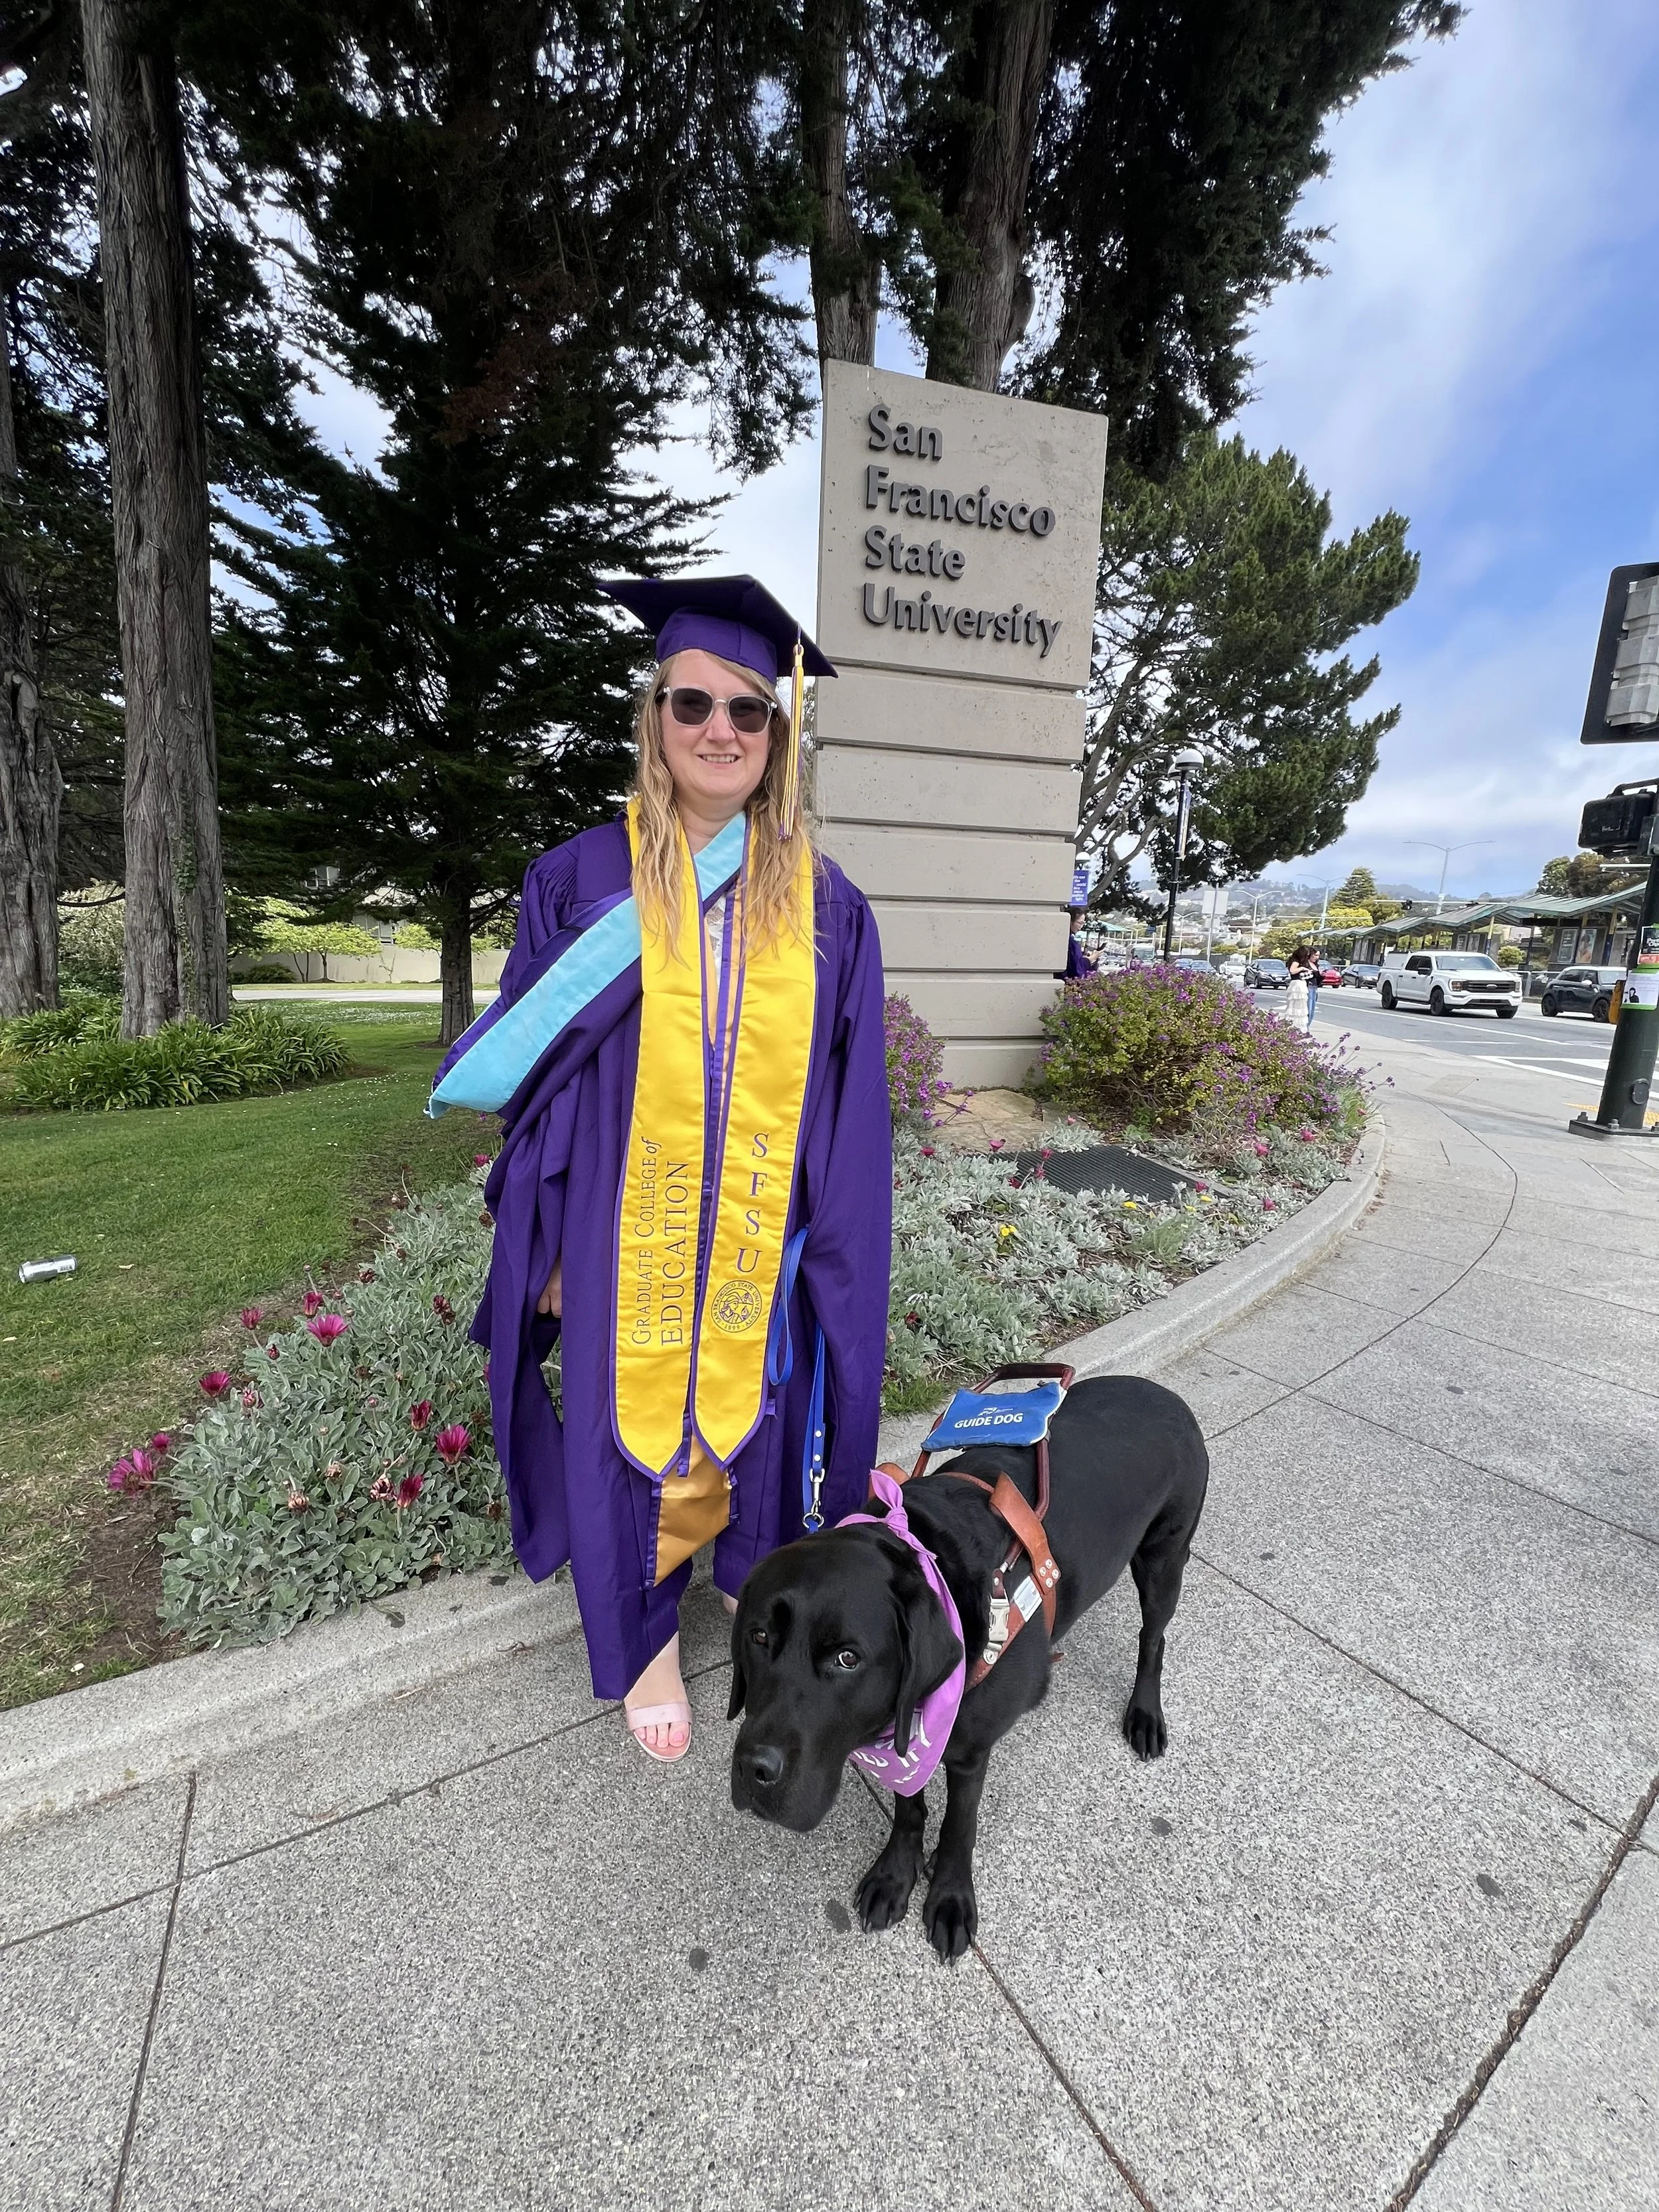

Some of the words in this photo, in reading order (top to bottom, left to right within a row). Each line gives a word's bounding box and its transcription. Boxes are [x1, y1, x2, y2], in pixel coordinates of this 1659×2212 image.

[868, 404, 943, 461] San
[866, 465, 1056, 536] Francisco
[865, 525, 966, 579] State
[863, 582, 1062, 658] University
[641, 1136, 662, 1153] of
[634, 1157, 656, 1237] COLLEGE
[737, 1132, 769, 1273] SFSU
[660, 1161, 689, 1346] EDUCATION
[632, 1249, 653, 1344] GRADUATE
[713, 1282, 736, 1310] FRANCISCO
[738, 1282, 754, 1291] STATE
[745, 1291, 760, 1326] UNIVERSITY
[954, 1416, 992, 1429] GUIDE
[993, 1412, 1024, 1425] DOG
